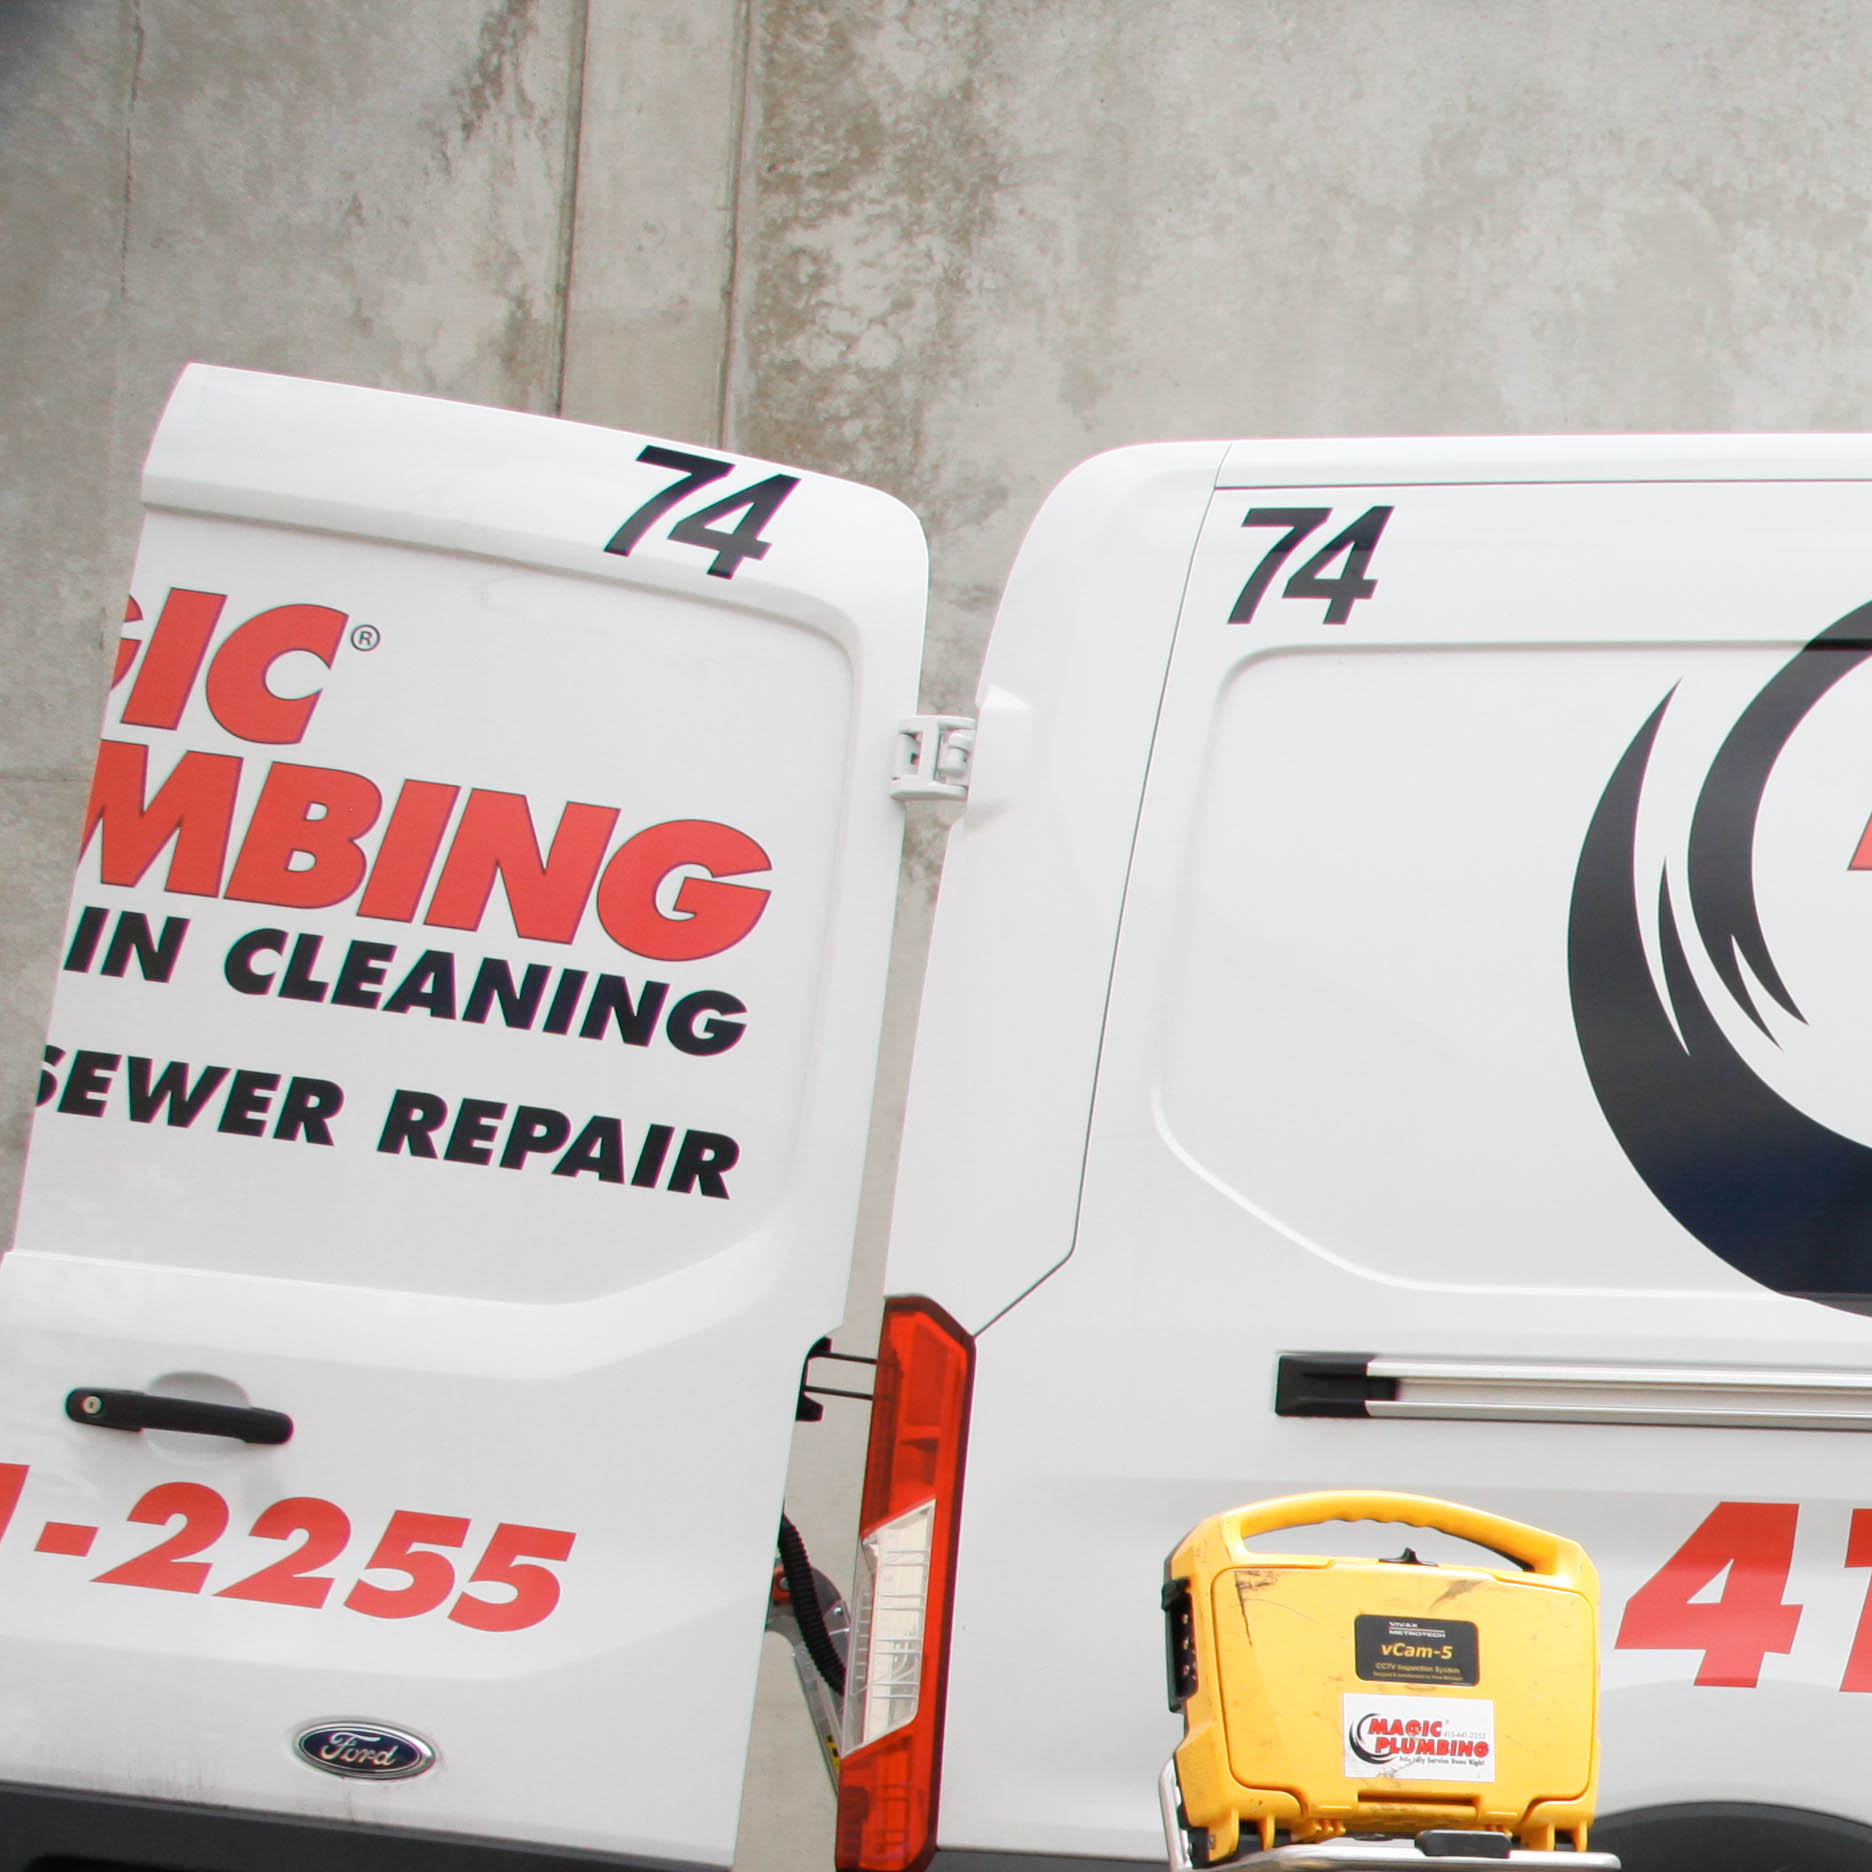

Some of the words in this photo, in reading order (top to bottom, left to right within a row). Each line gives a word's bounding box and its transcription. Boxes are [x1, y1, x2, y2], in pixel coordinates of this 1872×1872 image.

[604, 446, 801, 580] 74
[1227, 505, 1395, 625] 74
[110, 586, 350, 745] IC
[77, 738, 773, 962] MBING
[64, 906, 190, 983] IN
[223, 927, 749, 1057] CLEANING
[376, 1088, 741, 1200] REPAIR
[1380, 1641, 1454, 1661] vCam-5
[319, 1731, 400, 1767] Ford
[1368, 1717, 1443, 1738] MAGIC
[1374, 1736, 1490, 1758] PLUMBING
